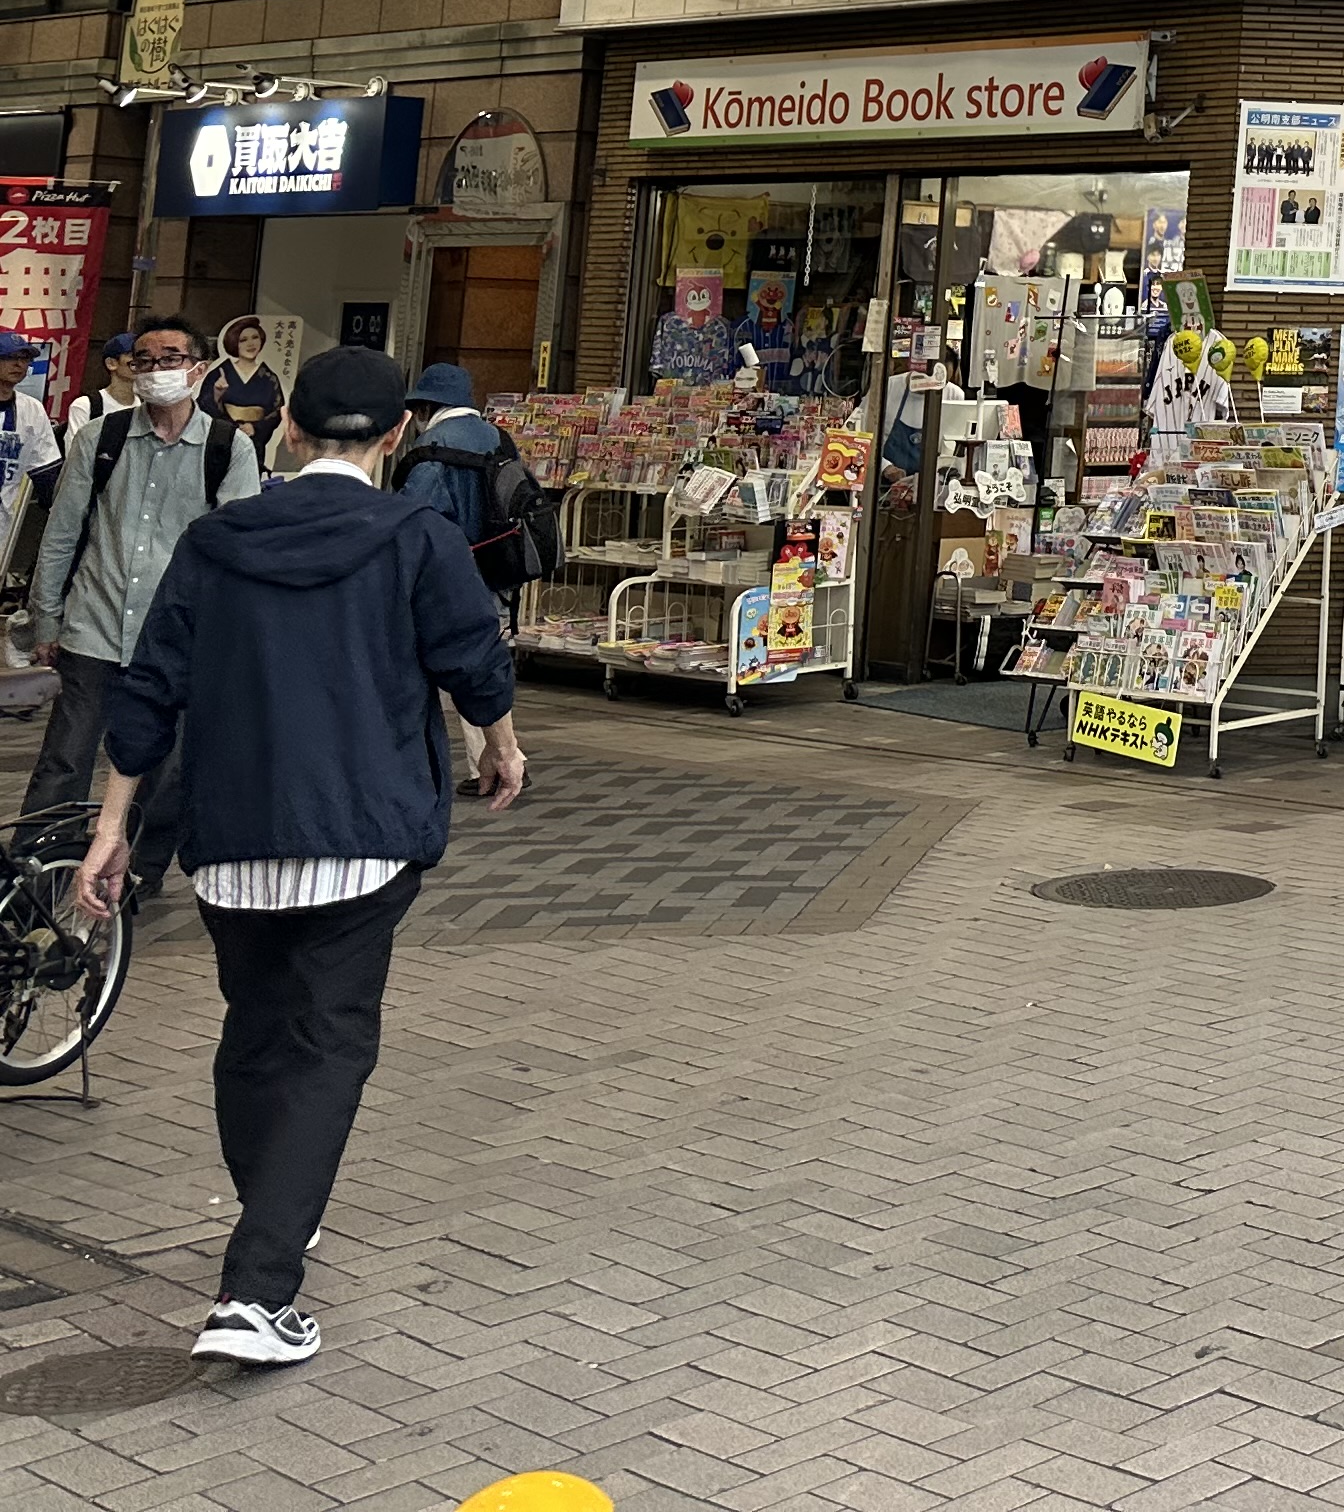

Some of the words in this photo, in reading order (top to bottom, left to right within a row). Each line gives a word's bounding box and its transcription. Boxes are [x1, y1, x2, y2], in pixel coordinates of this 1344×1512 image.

[862, 73, 954, 124] Book
[964, 74, 1066, 120] store
[232, 118, 348, 176] 買取大吉
[32, 190, 65, 202] Pizza
[65, 190, 91, 203] Hut
[229, 175, 278, 195] KAITORI
[278, 173, 333, 193] DAIKICHI
[0, 209, 92, 246] 2枚目
[985, 482, 1013, 495] ようこそ
[1082, 701, 1147, 731] 英語やるなら
[1076, 719, 1149, 750] NHKテキスト
